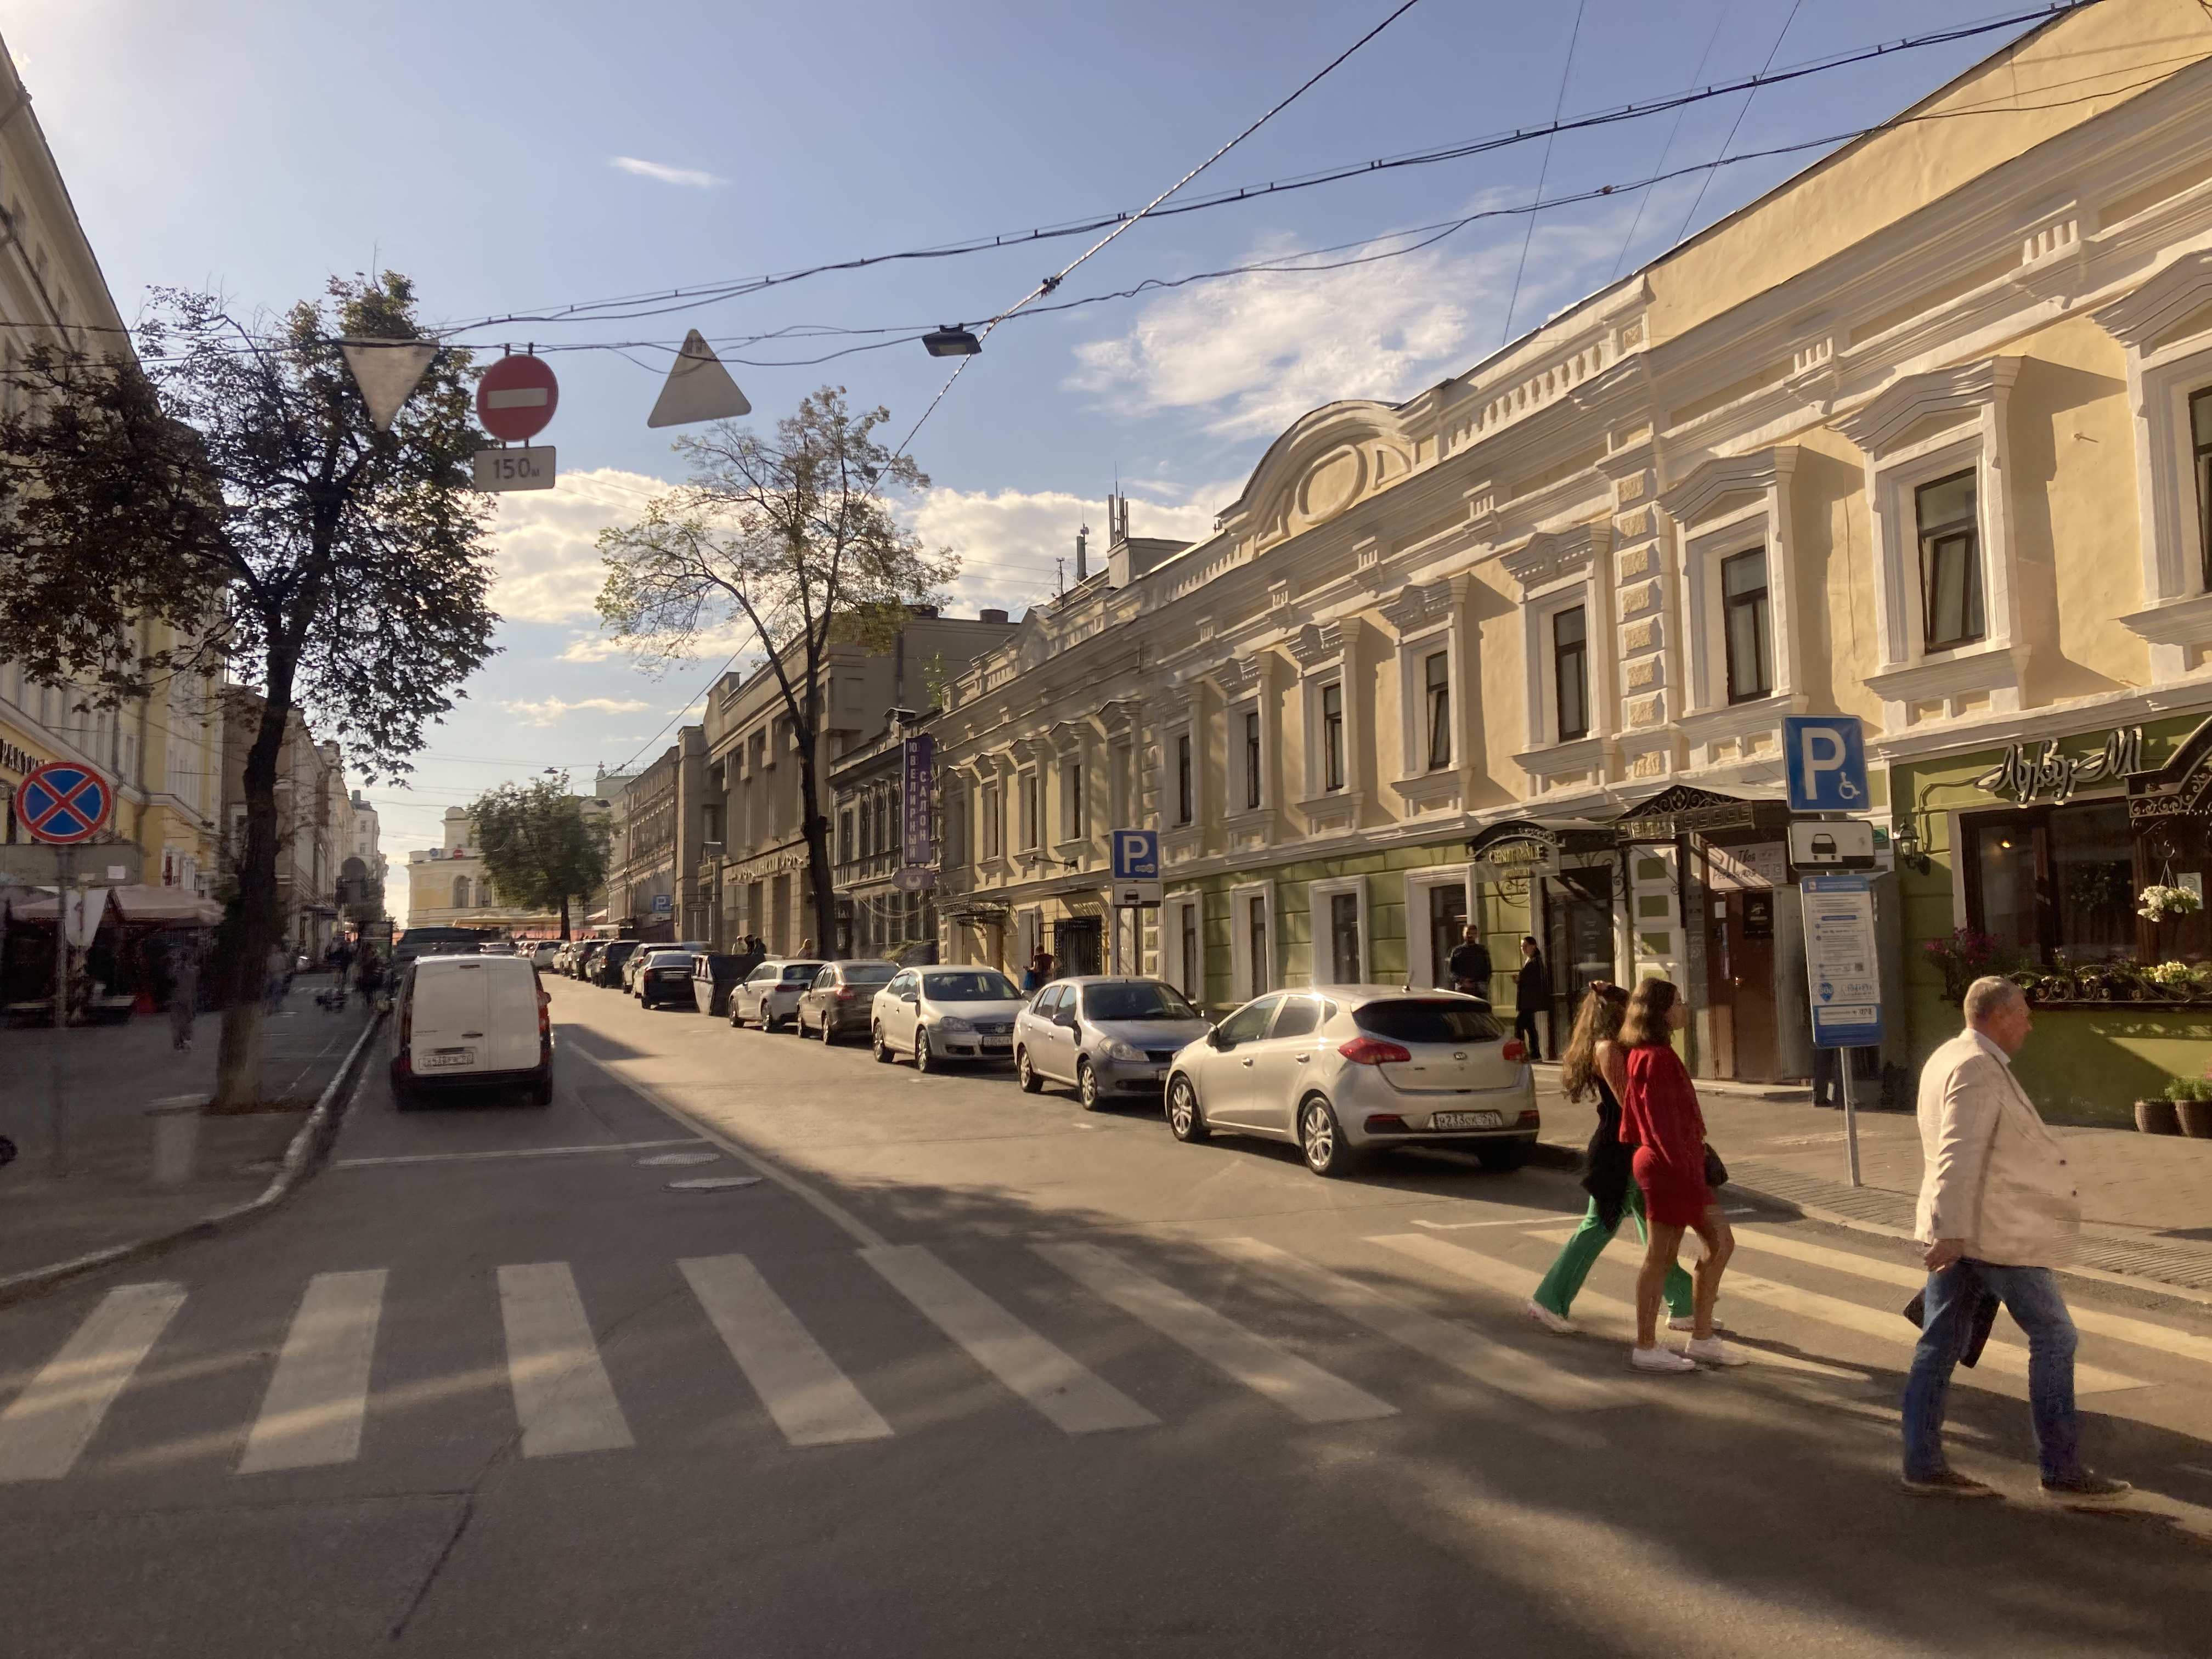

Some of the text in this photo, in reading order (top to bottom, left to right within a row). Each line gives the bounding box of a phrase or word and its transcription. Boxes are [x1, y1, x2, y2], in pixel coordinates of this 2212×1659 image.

[1802, 727, 1846, 800] P
[909, 742, 918, 858] ЮВЕЛИРНЫЙ
[919, 771, 928, 841] САЛОН
[1123, 836, 1148, 874] P
